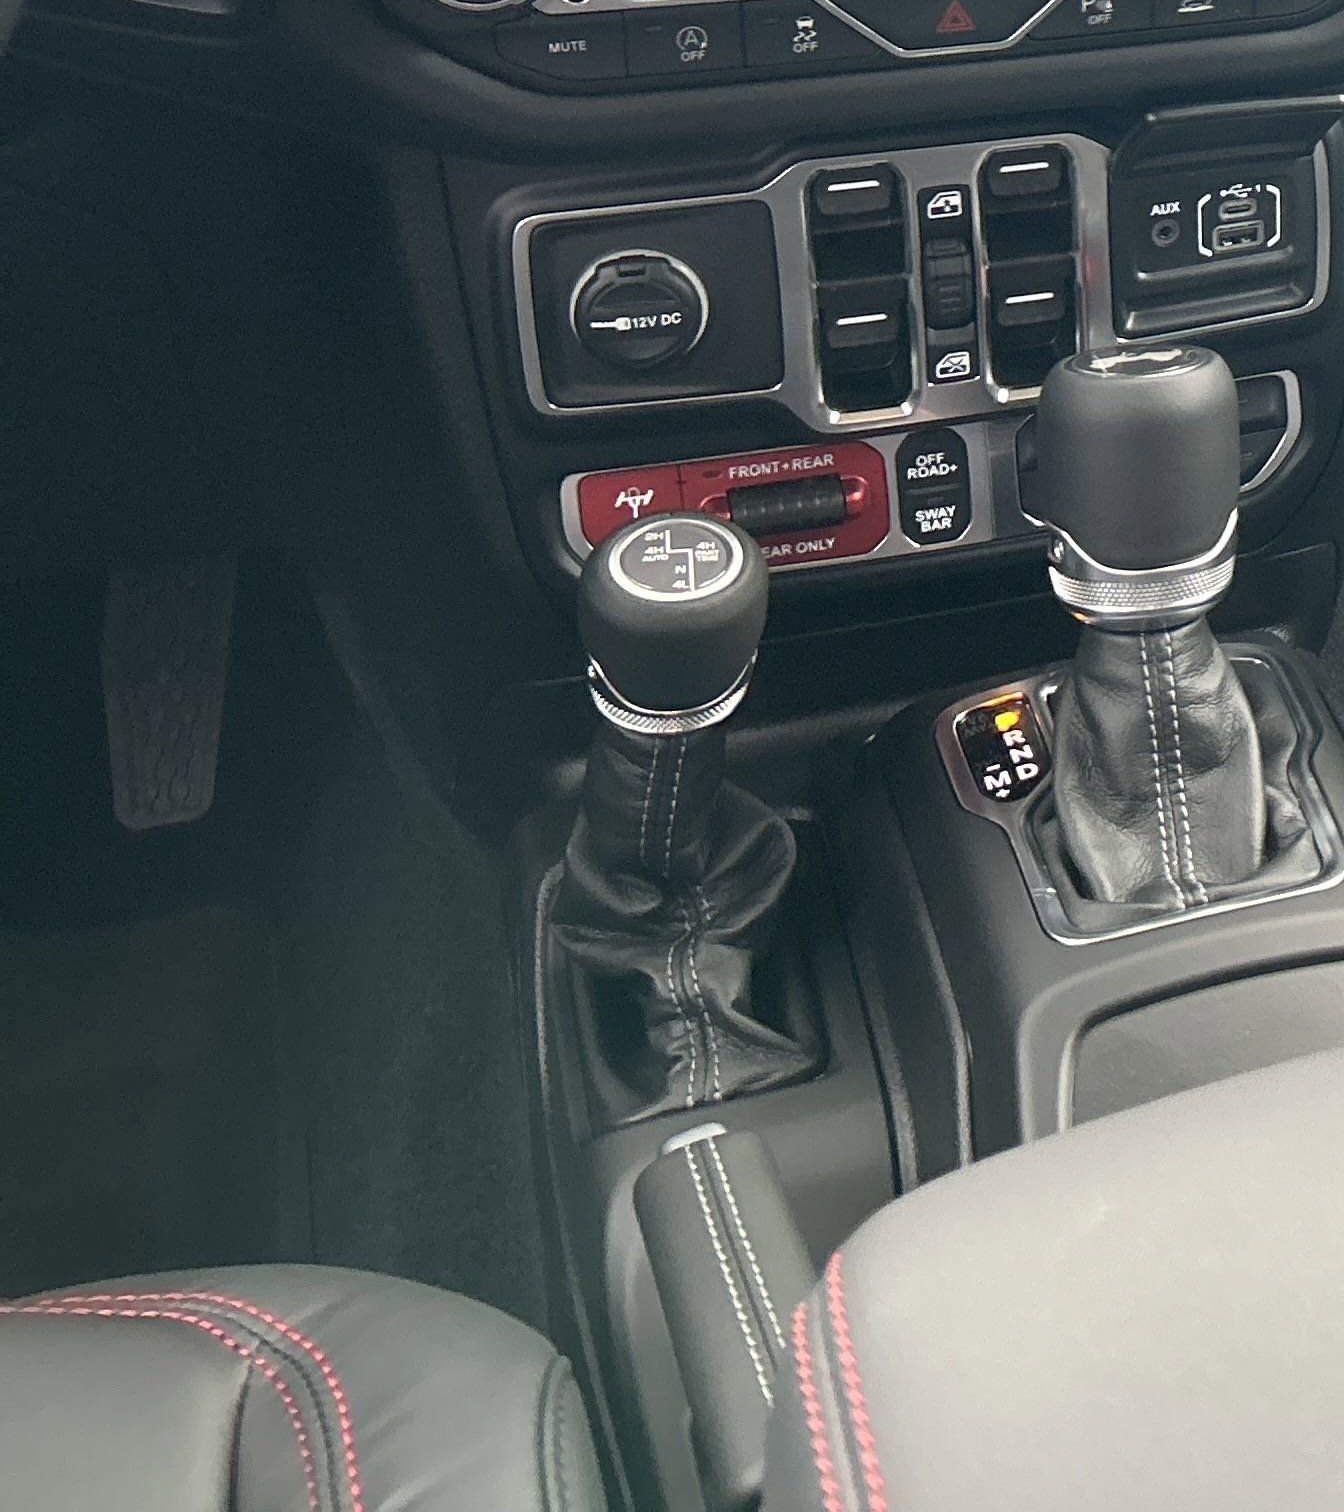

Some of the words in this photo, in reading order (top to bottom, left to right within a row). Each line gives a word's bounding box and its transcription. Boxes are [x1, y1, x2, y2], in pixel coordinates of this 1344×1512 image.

[1087, 12, 1113, 26] OFF
[548, 39, 588, 54] MUTE
[793, 41, 819, 54] OFF
[680, 49, 706, 63] OFF
[1150, 201, 1181, 217] AUX
[631, 315, 657, 329] 12V
[660, 311, 682, 327] DC
[915, 451, 945, 468] OFF
[914, 504, 957, 524] SWAY
[920, 516, 953, 534] BAR
[643, 545, 665, 555] 4H
[695, 541, 716, 550] 4H
[760, 543, 793, 560] EAR
[795, 535, 837, 555] ONLY
[641, 553, 670, 563] AUTO
[674, 564, 687, 575] N
[671, 579, 690, 589] 4L
[1002, 729, 1026, 747] R
[1009, 744, 1034, 764] N
[1015, 762, 1040, 781] D
[983, 770, 1013, 791] M
